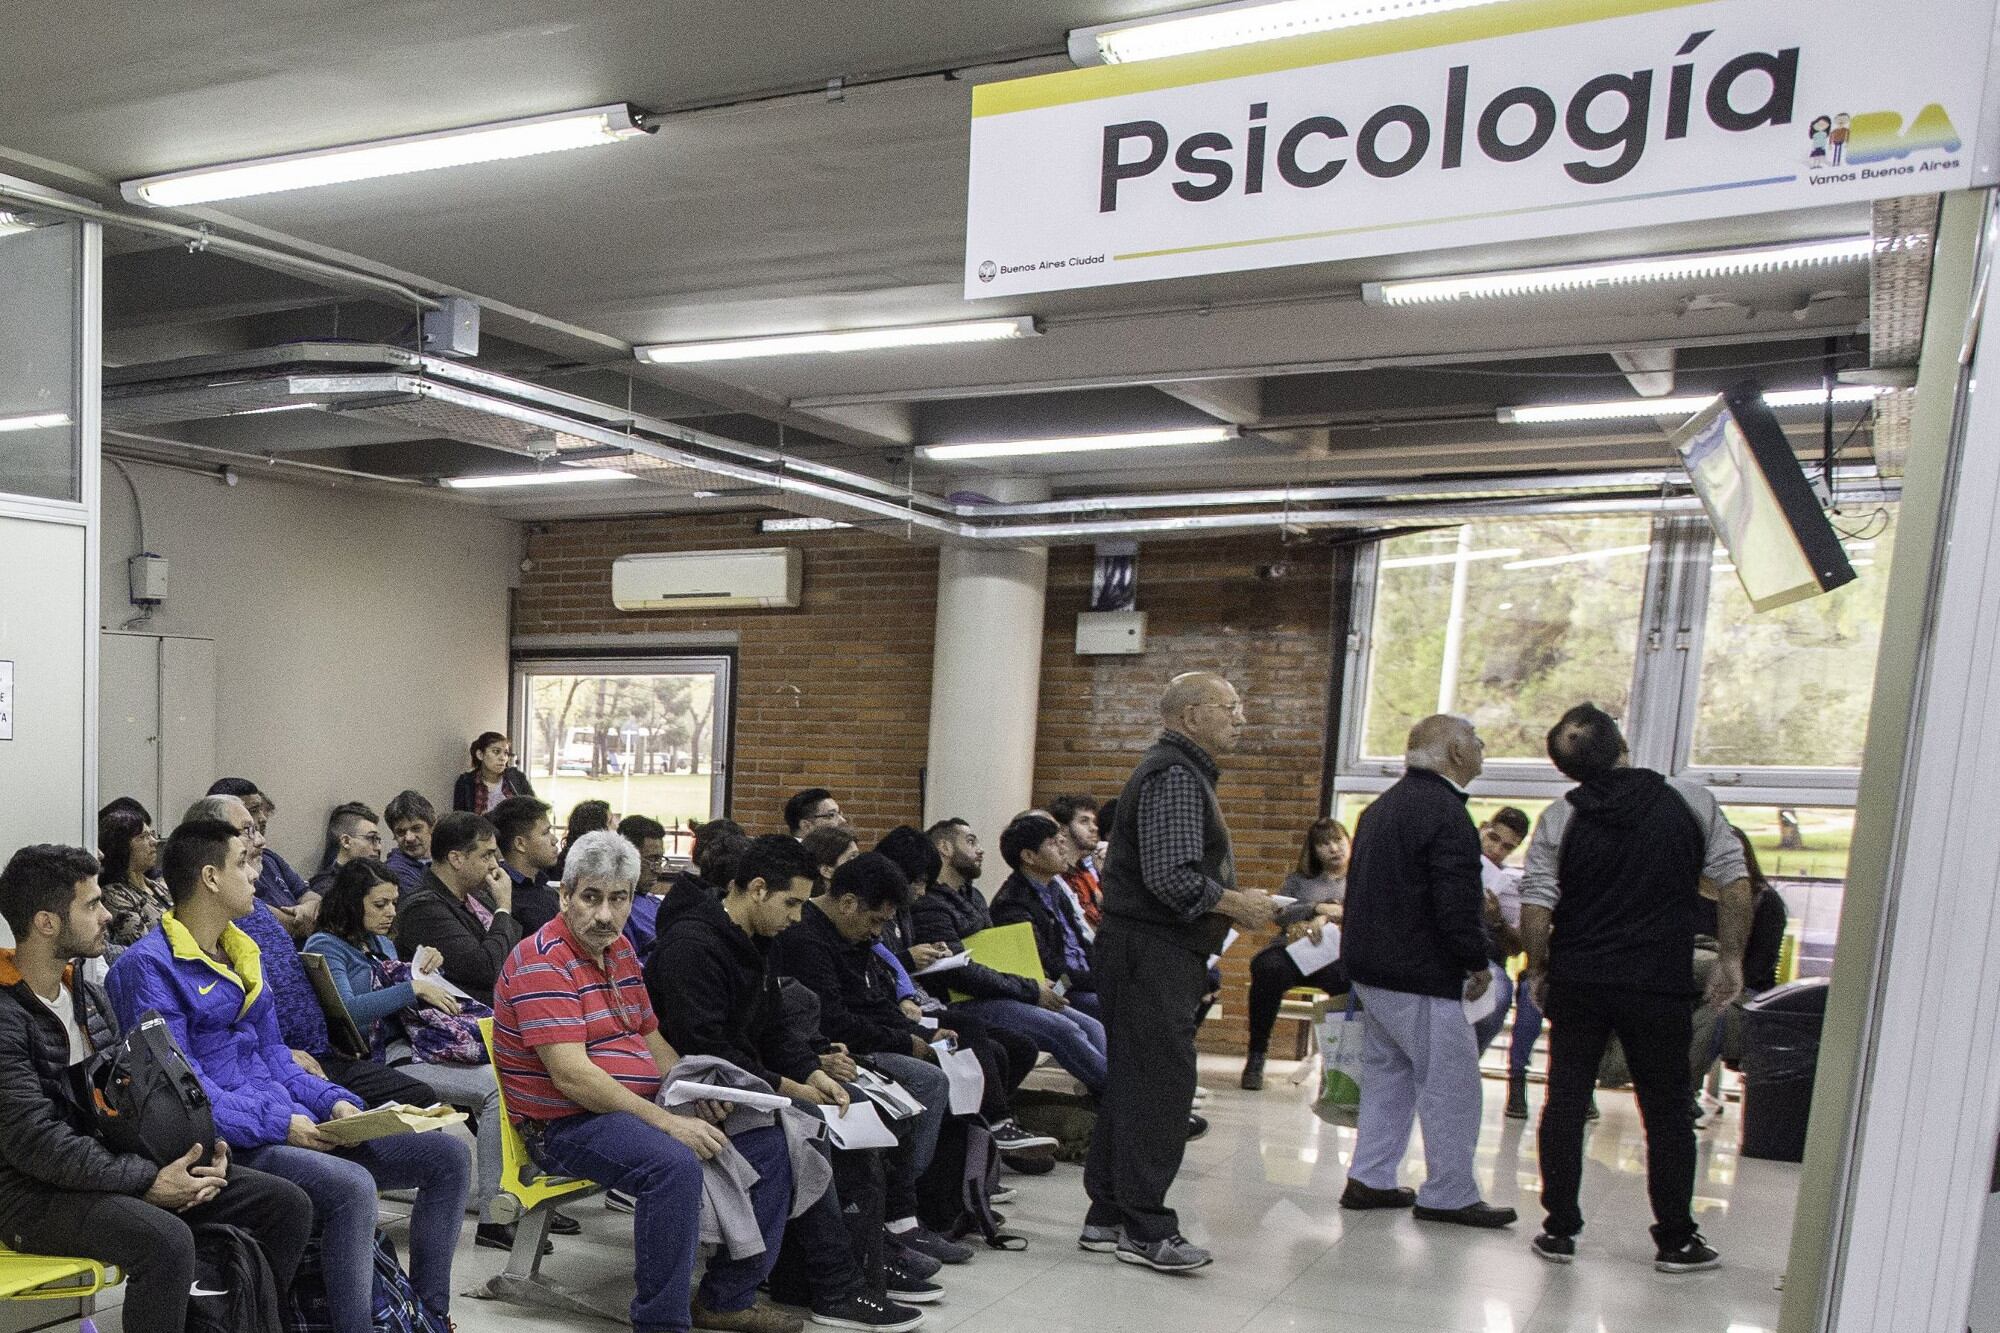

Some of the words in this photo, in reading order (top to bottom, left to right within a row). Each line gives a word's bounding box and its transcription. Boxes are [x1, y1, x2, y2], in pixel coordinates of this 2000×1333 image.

[1100, 29, 1800, 213] Psicología
[1809, 174, 1857, 185] Vamos
[1861, 165, 1914, 179] Buenos
[1919, 160, 1960, 173] Aires
[1000, 264, 1036, 274] Buenos
[1039, 260, 1066, 270] Aires
[1069, 254, 1105, 266] Ciudad
